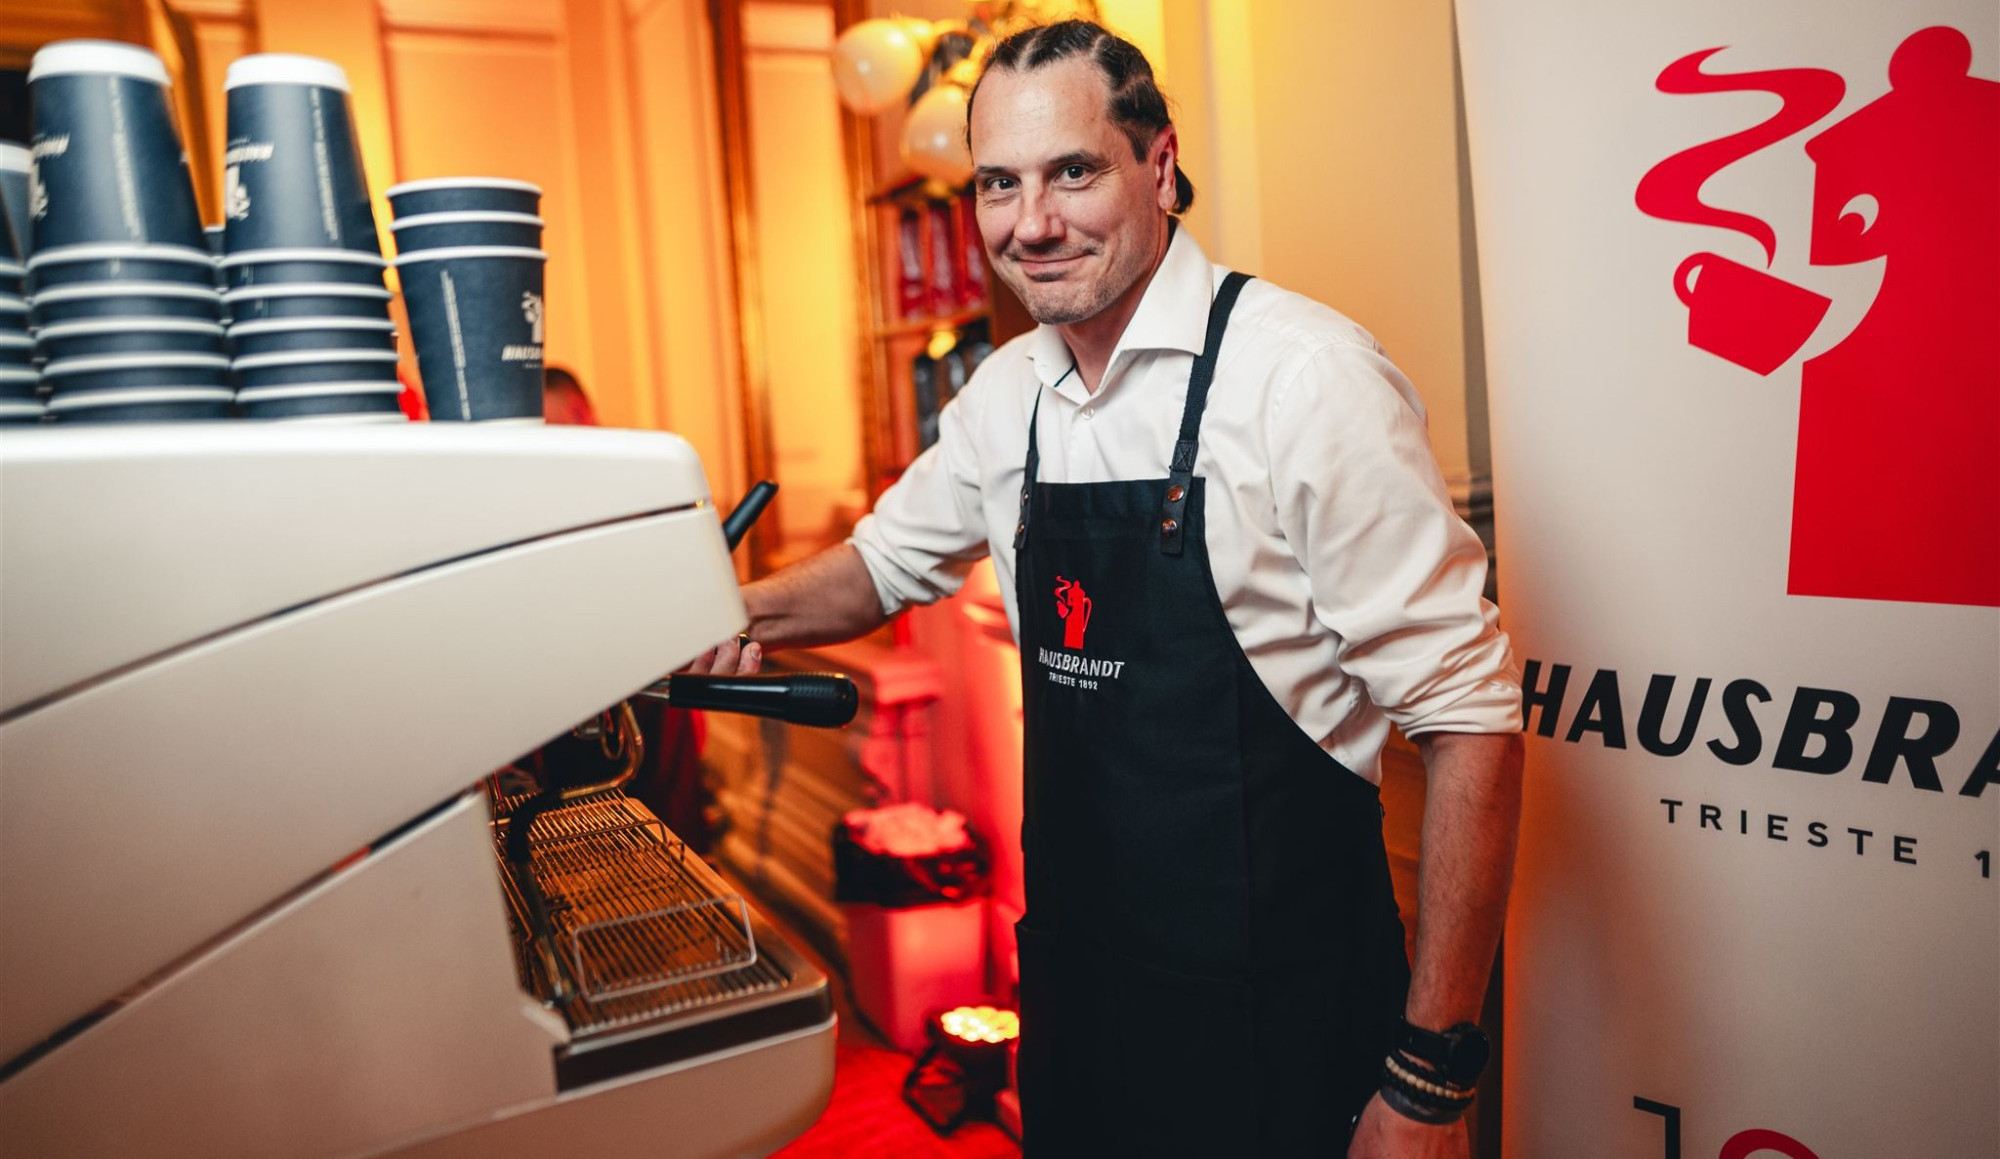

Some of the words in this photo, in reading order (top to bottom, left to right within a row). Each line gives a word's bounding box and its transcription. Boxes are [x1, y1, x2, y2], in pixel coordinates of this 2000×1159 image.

[1038, 646, 1125, 679] HAUSBRANDT
[1048, 671, 1076, 687] TRIESTE
[1078, 678, 1098, 690] 1892
[1659, 797, 1918, 865] TRIESTE
